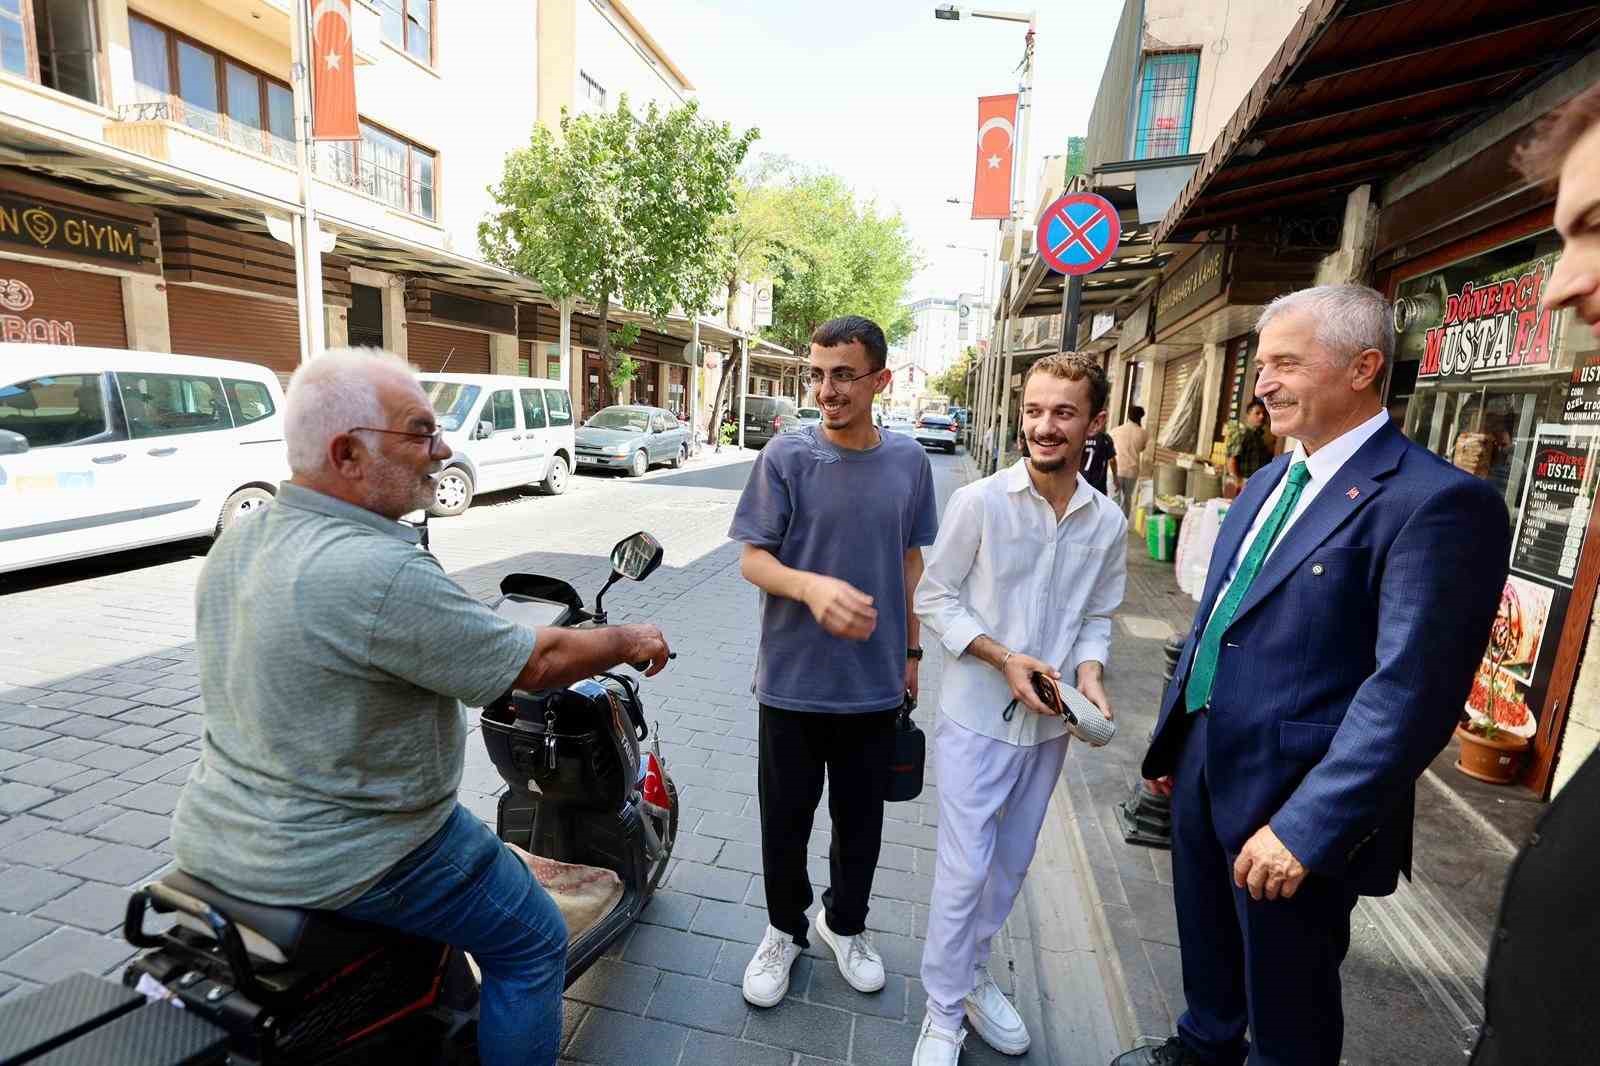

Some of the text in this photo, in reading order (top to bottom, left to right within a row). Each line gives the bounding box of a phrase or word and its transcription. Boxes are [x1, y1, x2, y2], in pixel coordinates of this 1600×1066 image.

[64, 219, 134, 256] GİYİM
[1444, 260, 1546, 326] DÖNERCİ
[1418, 308, 1553, 377] MUSTAFA
